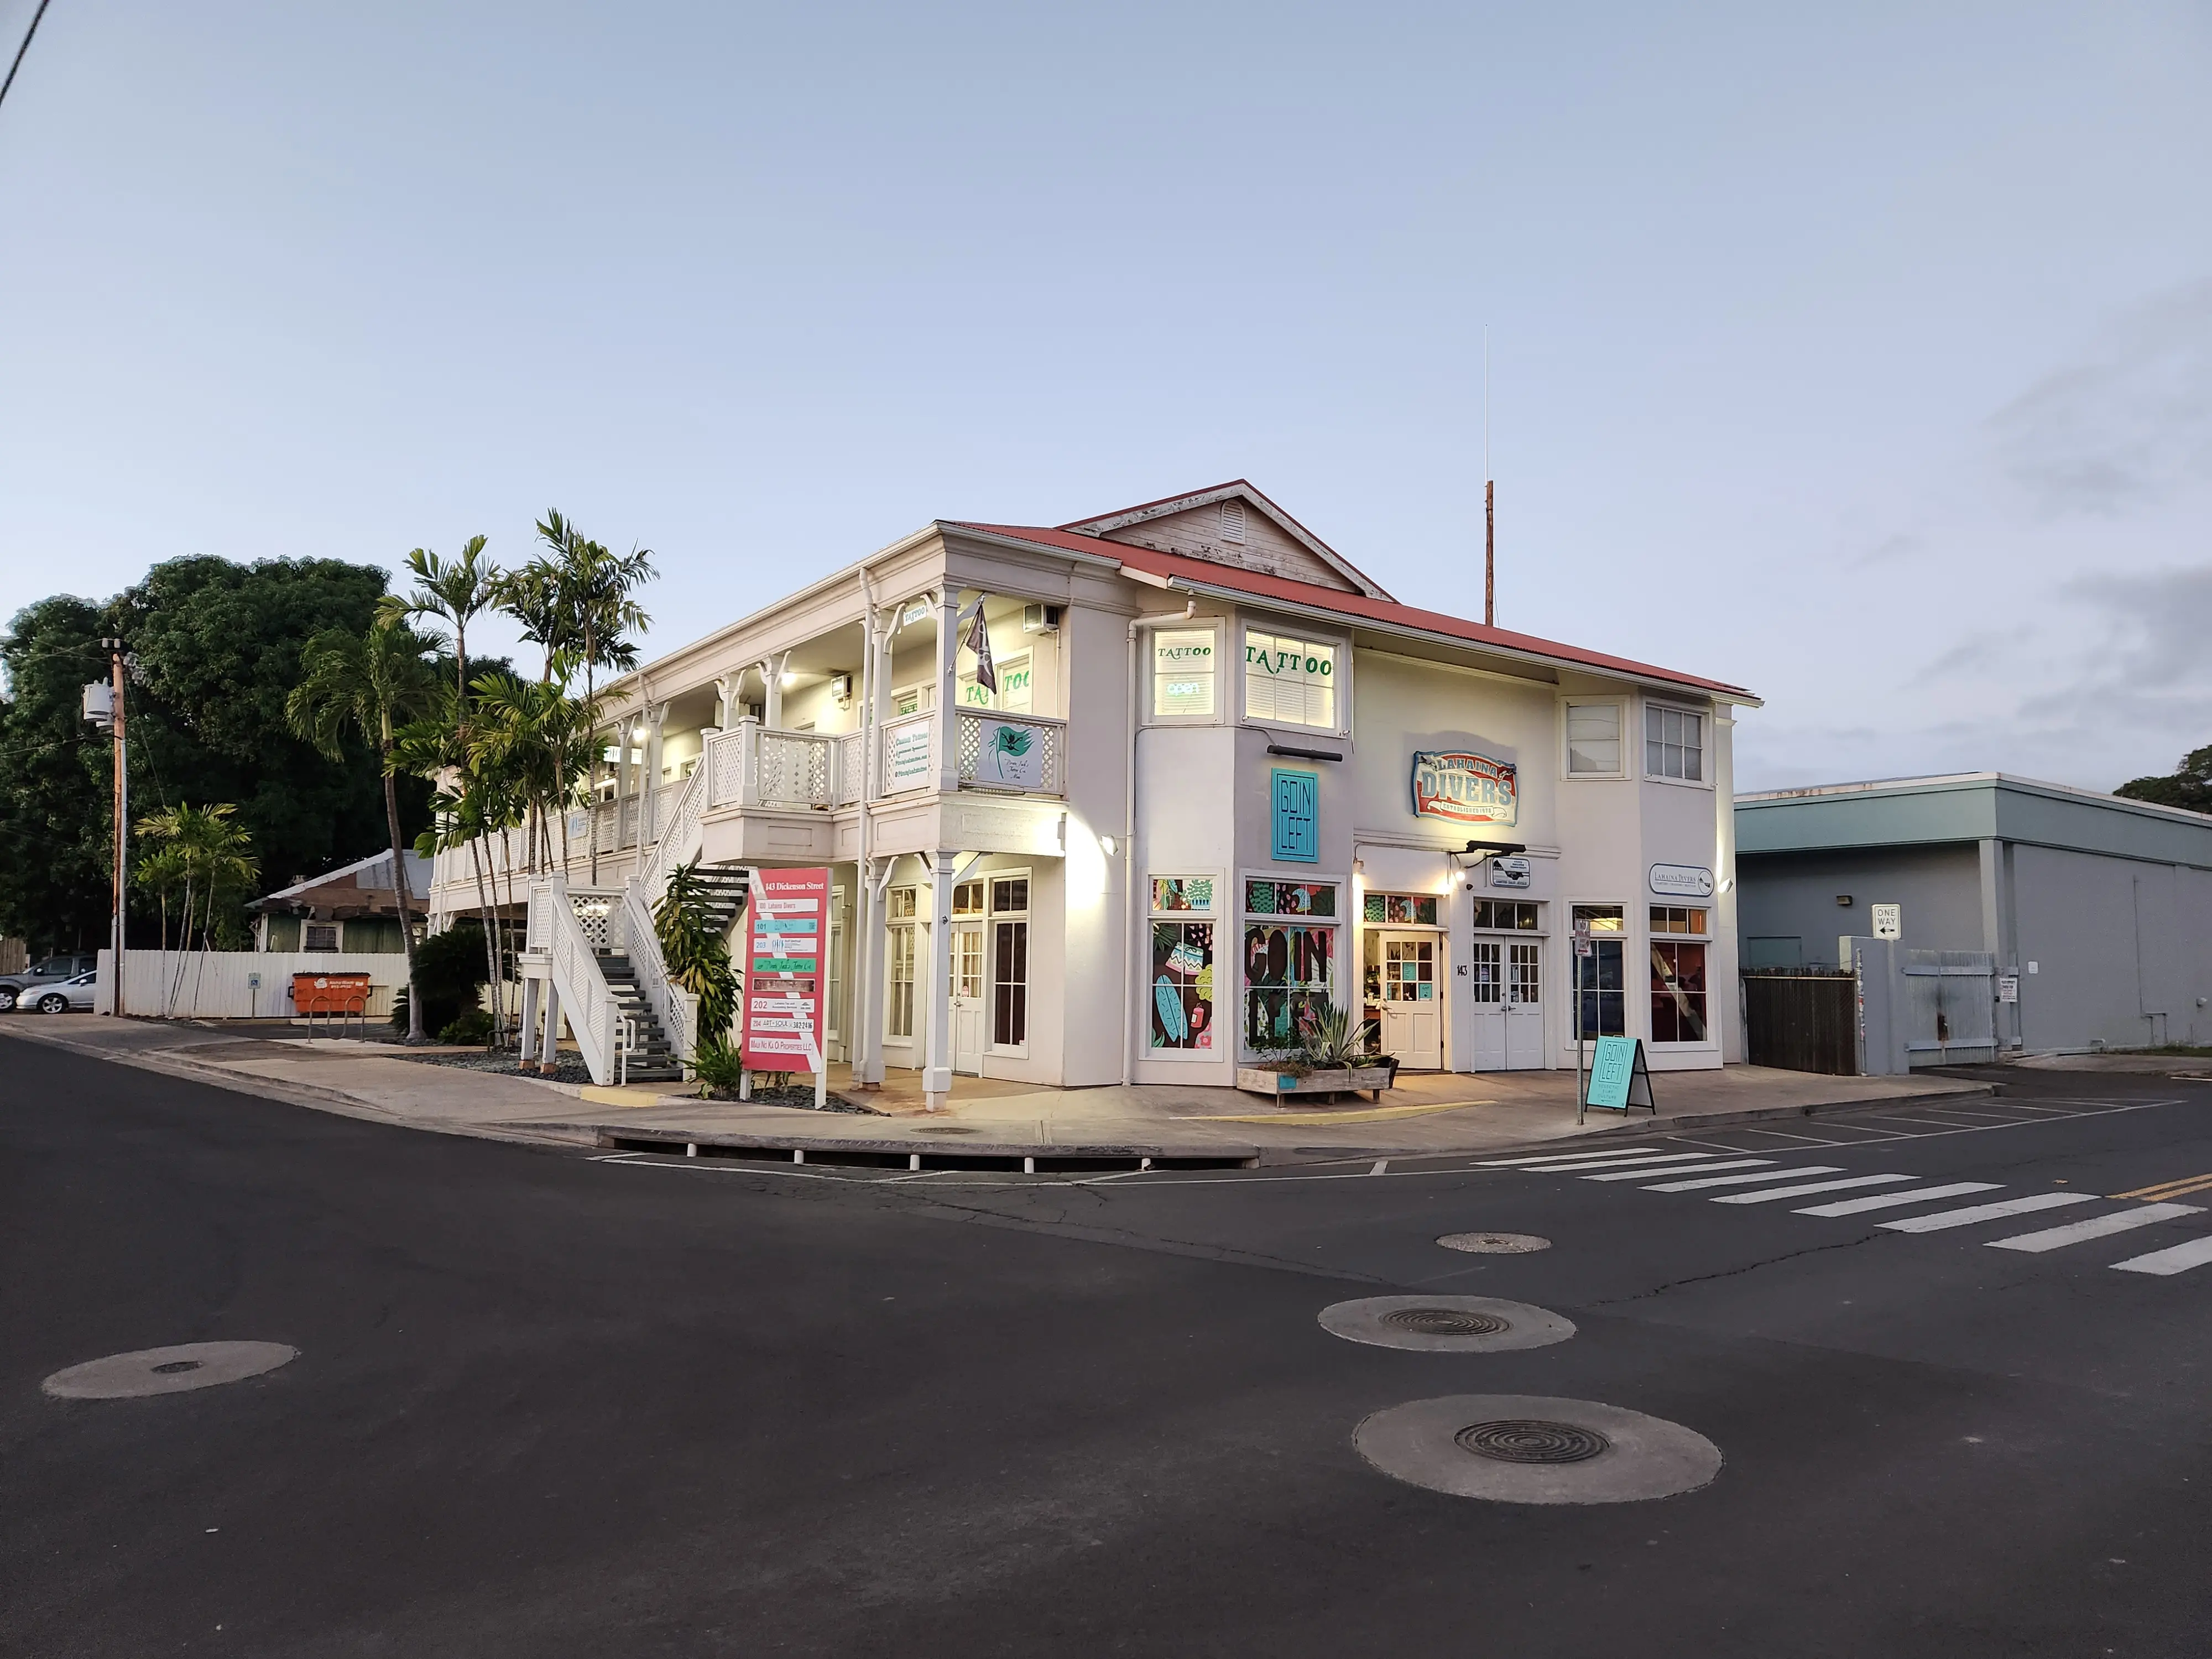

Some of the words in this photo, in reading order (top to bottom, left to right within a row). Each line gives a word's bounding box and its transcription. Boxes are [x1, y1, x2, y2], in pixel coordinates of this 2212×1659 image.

[905, 606, 925, 622] TATTOO
[1158, 647, 1211, 660] TATTOO
[1246, 646, 1332, 676] TATTOO
[1438, 758, 1498, 779] LAHAINA
[1281, 780, 1311, 815] GOIN
[1422, 772, 1512, 806] DIVERS
[1281, 816, 1311, 851] LEFT
[765, 882, 775, 891] 143
[776, 882, 806, 890] Dickenson
[806, 881, 824, 890] Street
[1655, 872, 1678, 881] LAHAINA
[1244, 928, 1327, 983] GOIN
[1457, 965, 1468, 976] 143
[1249, 990, 1329, 1048] LEFT
[1605, 1044, 1625, 1062] GOIN
[1601, 1063, 1622, 1080] LEFT
